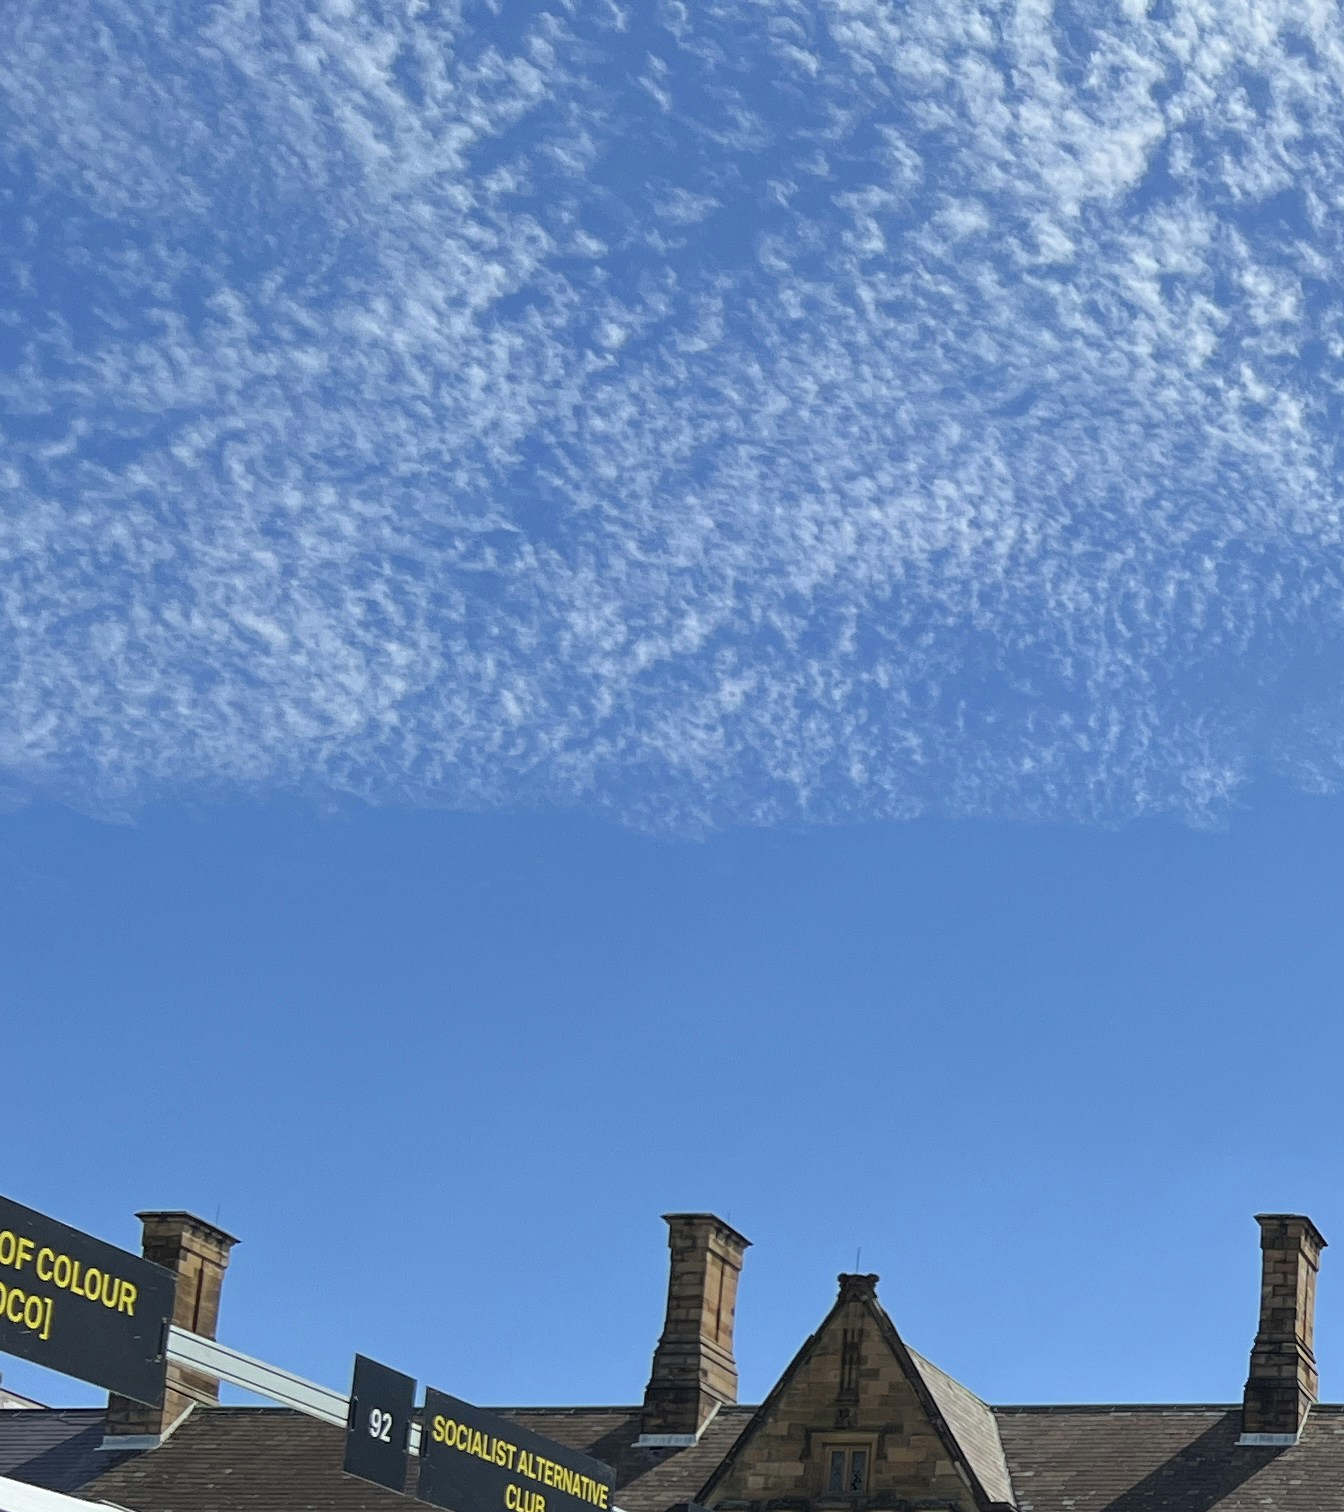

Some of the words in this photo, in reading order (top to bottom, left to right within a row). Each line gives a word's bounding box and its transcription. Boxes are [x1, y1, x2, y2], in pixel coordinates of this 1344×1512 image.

[0, 1230, 35, 1270] OF
[36, 1247, 138, 1316] COLOUR
[369, 1408, 392, 1443] 92
[432, 1415, 516, 1470] SOCIALIST
[517, 1450, 608, 1509] ALTERNATIVE
